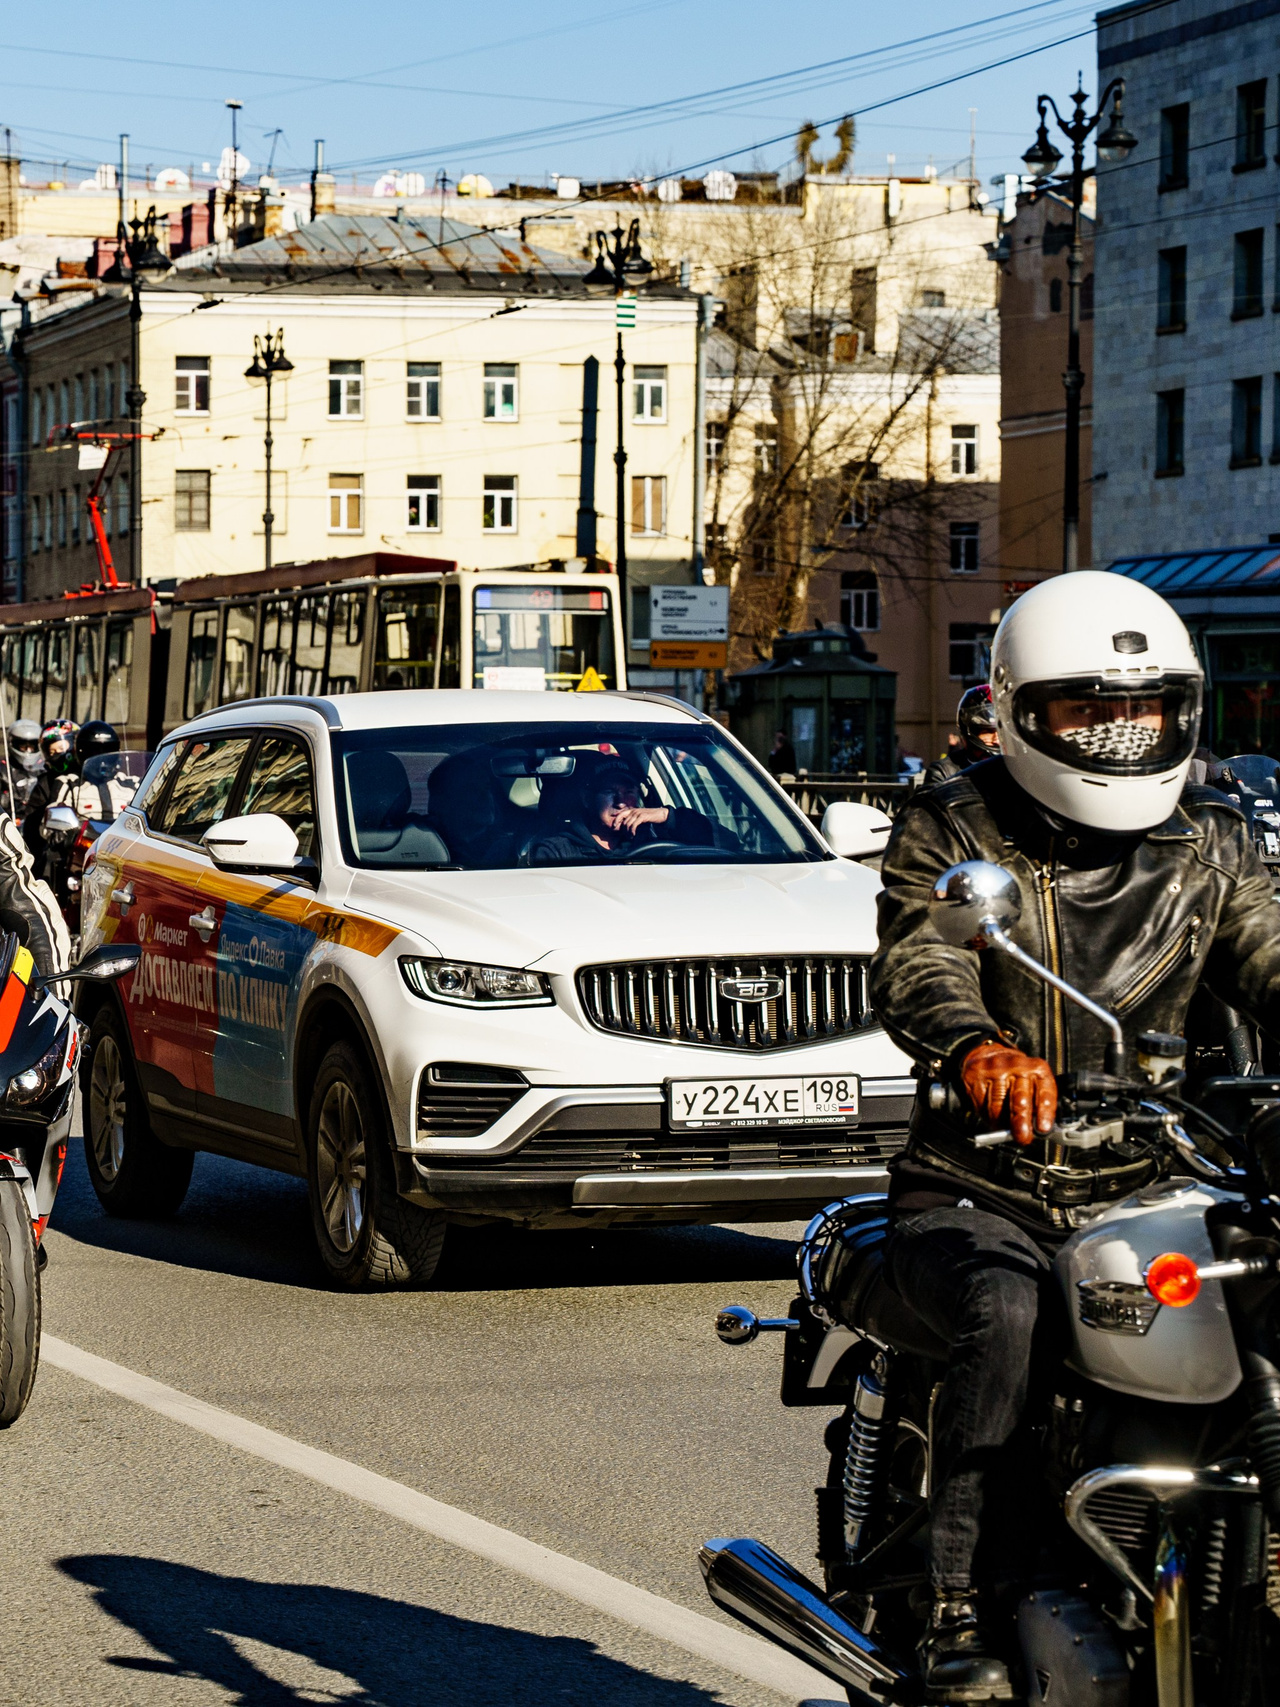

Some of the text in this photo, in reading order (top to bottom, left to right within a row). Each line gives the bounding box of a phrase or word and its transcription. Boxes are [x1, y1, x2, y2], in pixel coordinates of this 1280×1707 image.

[154, 922, 188, 947] Маркет
[221, 934, 285, 969] Яндекс Лавка
[129, 952, 215, 1013] ДОСТАВЛЯЕМ
[219, 970, 237, 1020] ПО
[239, 975, 288, 1032] КЛИКУ
[683, 1084, 799, 1115] У224ХЕ
[806, 1080, 849, 1103] 198
[816, 1103, 837, 1112] RUS
